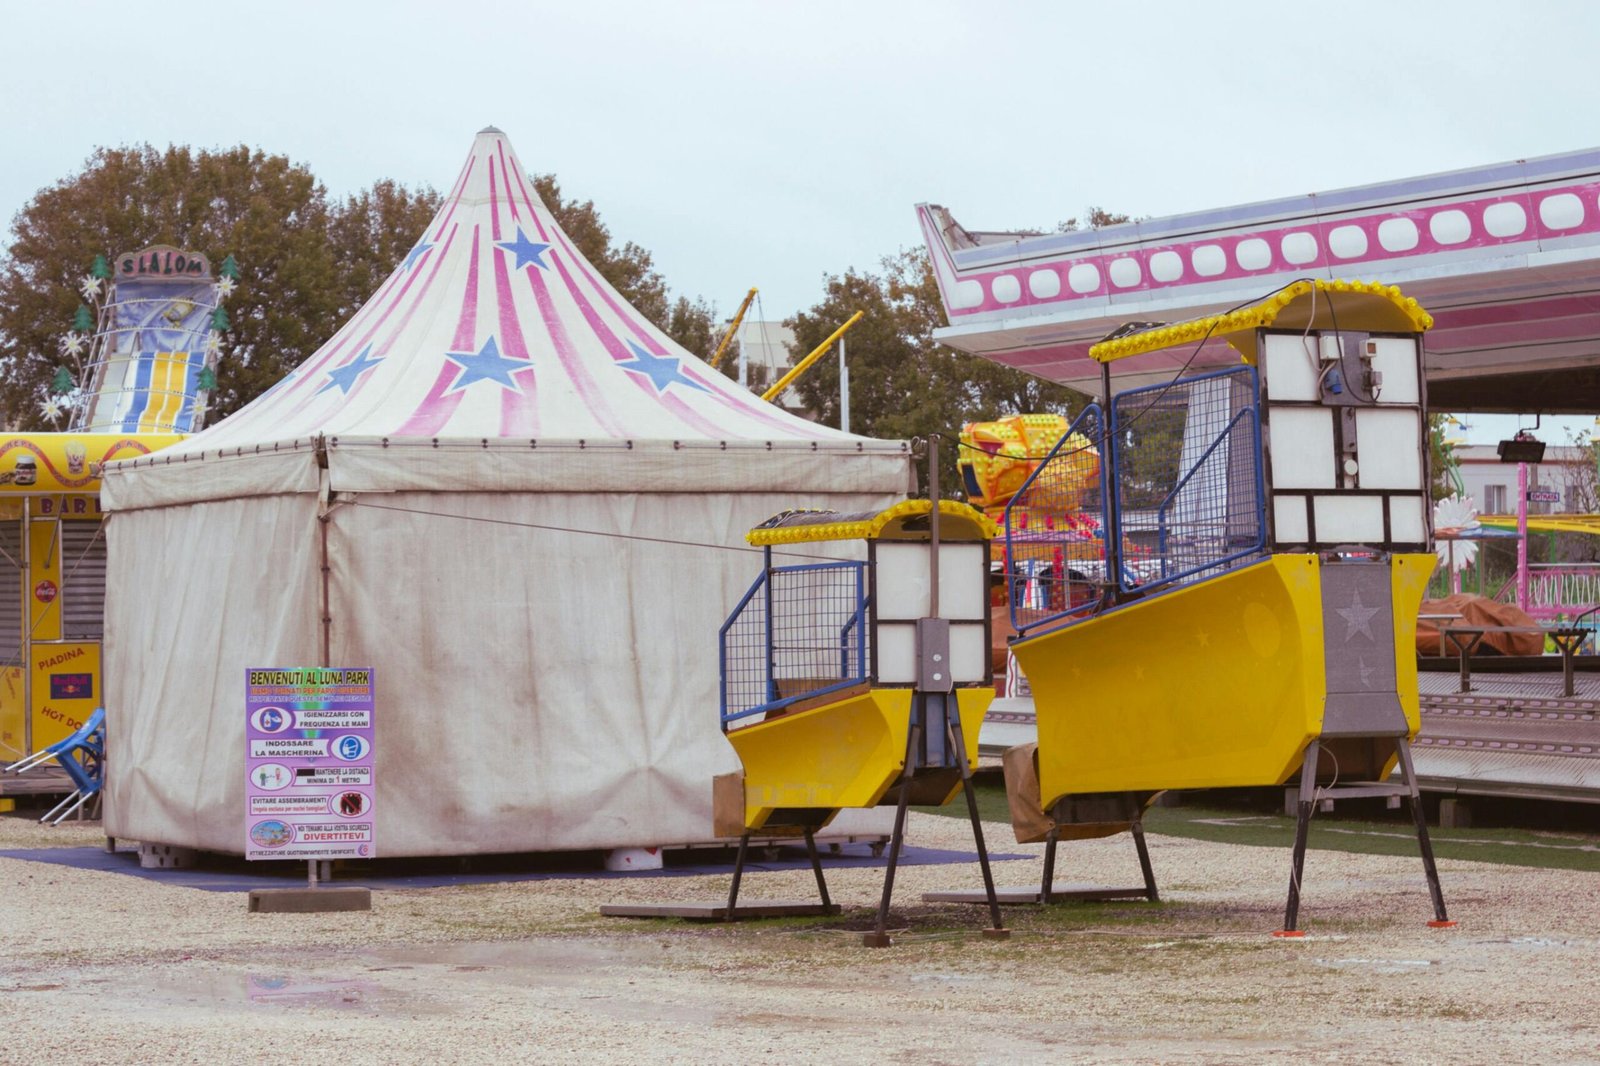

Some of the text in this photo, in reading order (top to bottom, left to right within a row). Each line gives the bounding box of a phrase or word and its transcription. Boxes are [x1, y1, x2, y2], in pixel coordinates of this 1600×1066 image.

[122, 252, 202, 274] SLALOM
[38, 647, 85, 670] PIADINA
[251, 672, 369, 685] BENVENUTI AL LUNA PARK
[41, 706, 83, 731] HOT DO
[336, 775, 340, 783] 1
[304, 832, 364, 840] DIVERTITEVI
